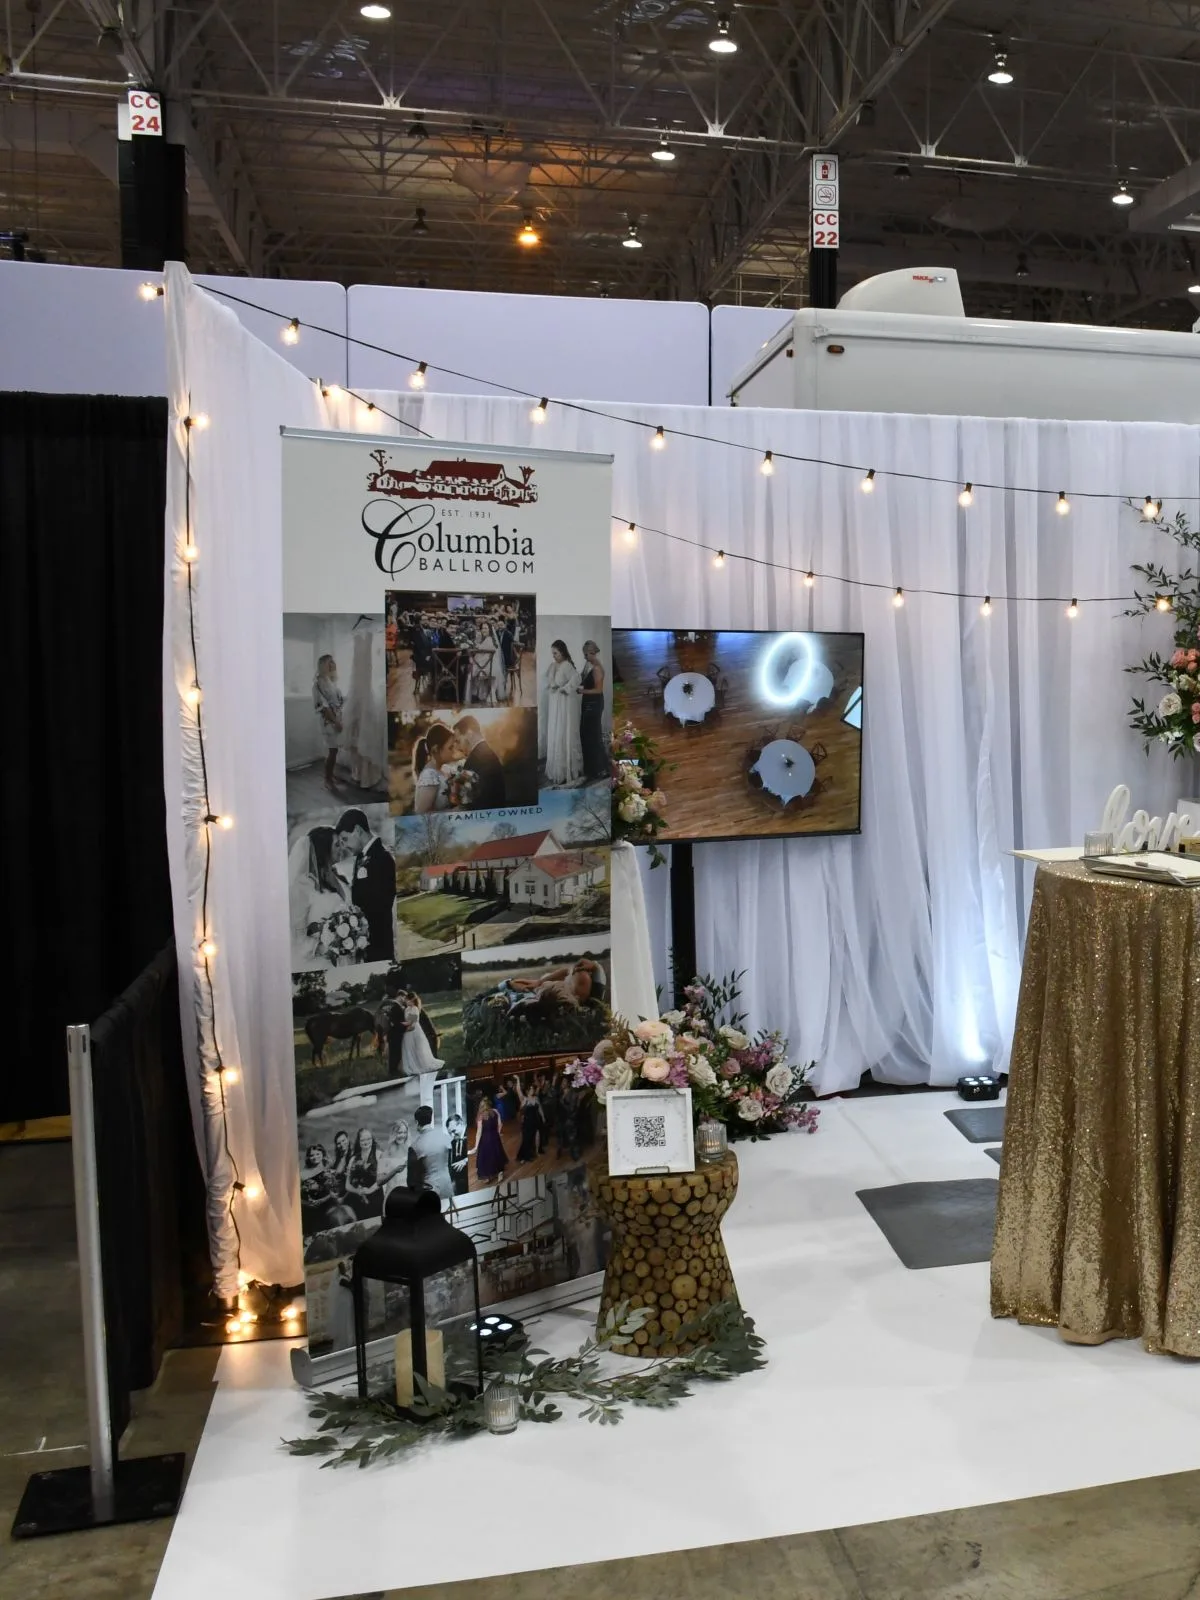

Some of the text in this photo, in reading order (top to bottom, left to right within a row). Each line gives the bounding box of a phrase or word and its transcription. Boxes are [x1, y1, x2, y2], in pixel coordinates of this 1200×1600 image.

[131, 95, 160, 109] CC
[131, 115, 160, 132] 24
[815, 213, 837, 226] CC
[815, 231, 838, 246] 22
[441, 509, 492, 519] EST. 1931
[361, 498, 536, 582] Columbia
[419, 557, 534, 574] BALLROOM
[448, 807, 543, 821] FAMILY OWNED
